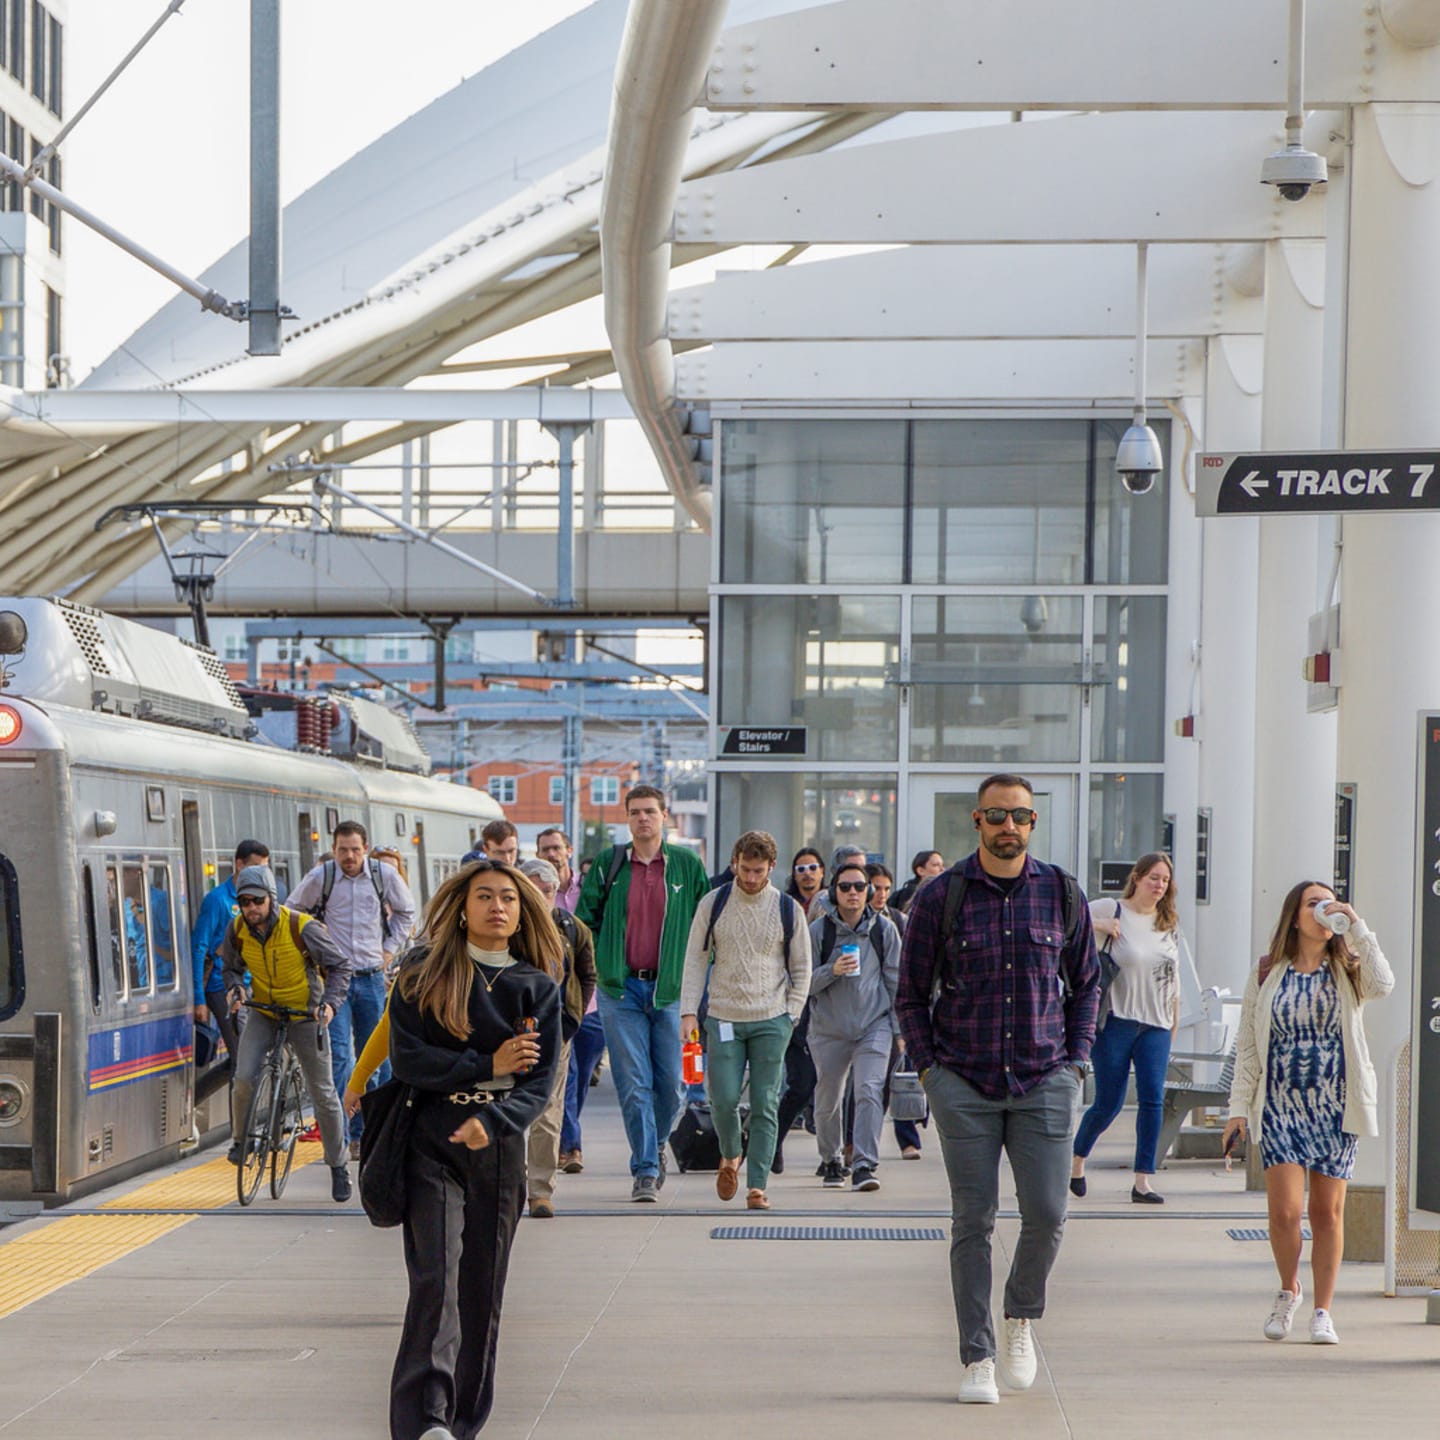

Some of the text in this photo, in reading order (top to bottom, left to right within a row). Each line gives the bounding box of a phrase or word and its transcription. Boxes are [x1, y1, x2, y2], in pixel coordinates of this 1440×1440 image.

[1203, 456, 1224, 468] RTD
[1276, 464, 1435, 498] TRACK 7
[738, 730, 783, 741] Elevator
[738, 742, 771, 752] Stairs
